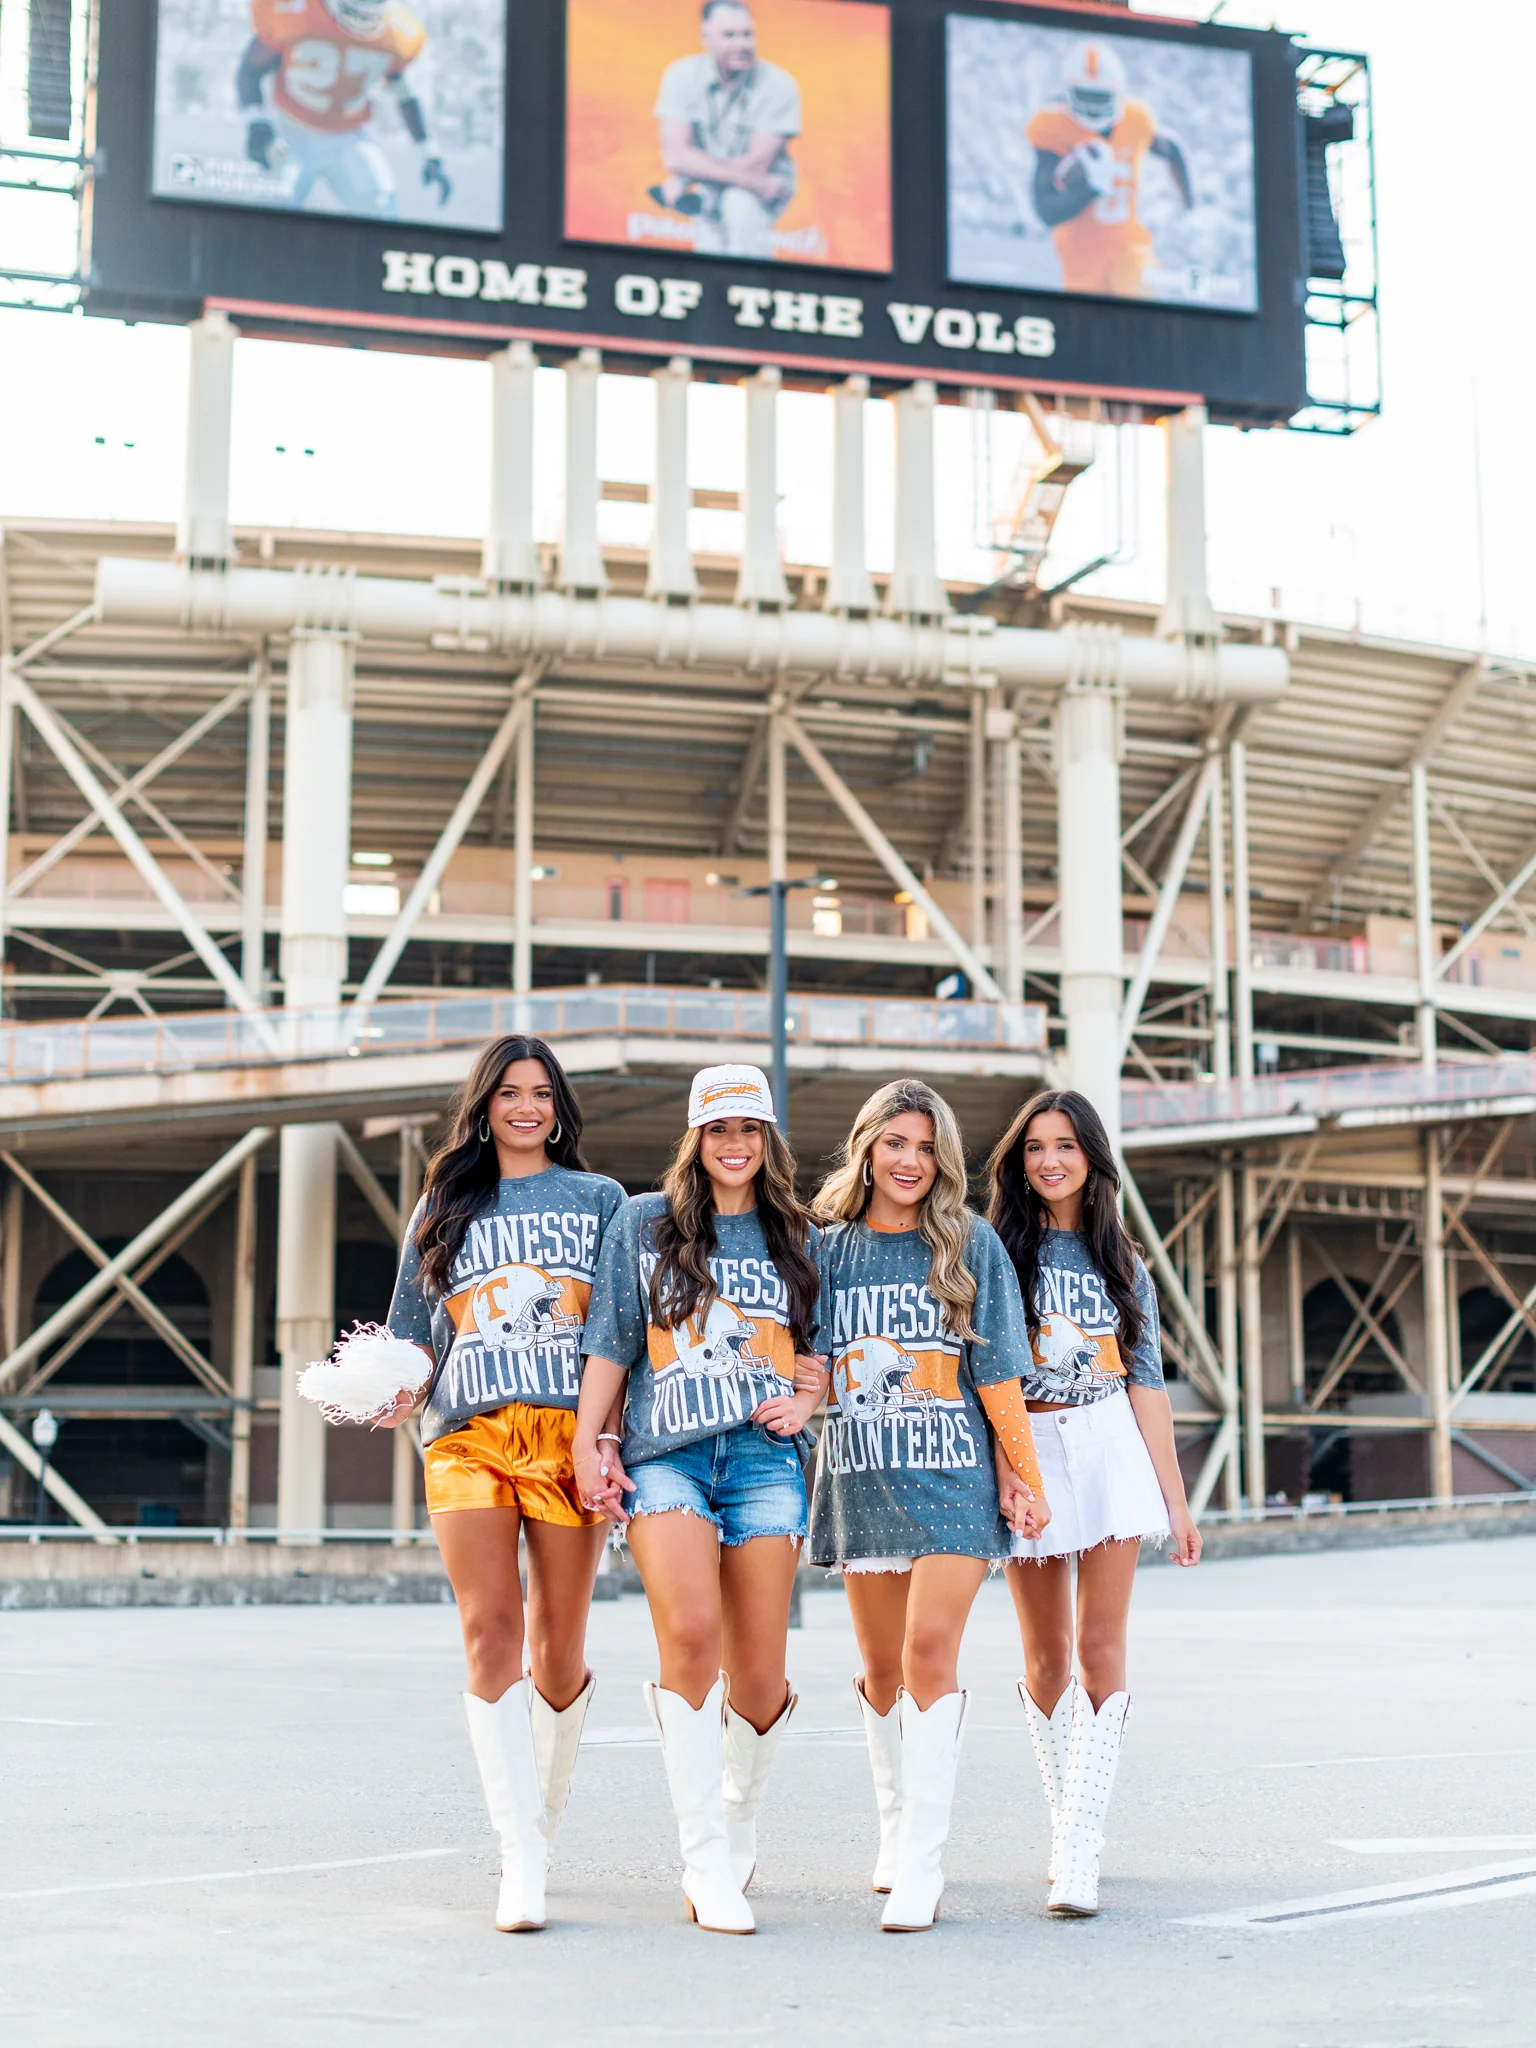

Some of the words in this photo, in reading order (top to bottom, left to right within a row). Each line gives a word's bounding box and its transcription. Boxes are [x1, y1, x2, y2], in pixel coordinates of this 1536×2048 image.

[286, 40, 392, 112] 27
[382, 251, 587, 310] HOME
[614, 274, 702, 320] OF
[727, 285, 864, 338] THE
[887, 303, 1056, 357] VOLS
[449, 1211, 598, 1280] ENNESSE
[477, 1276, 508, 1322] T
[837, 1349, 864, 1392] T
